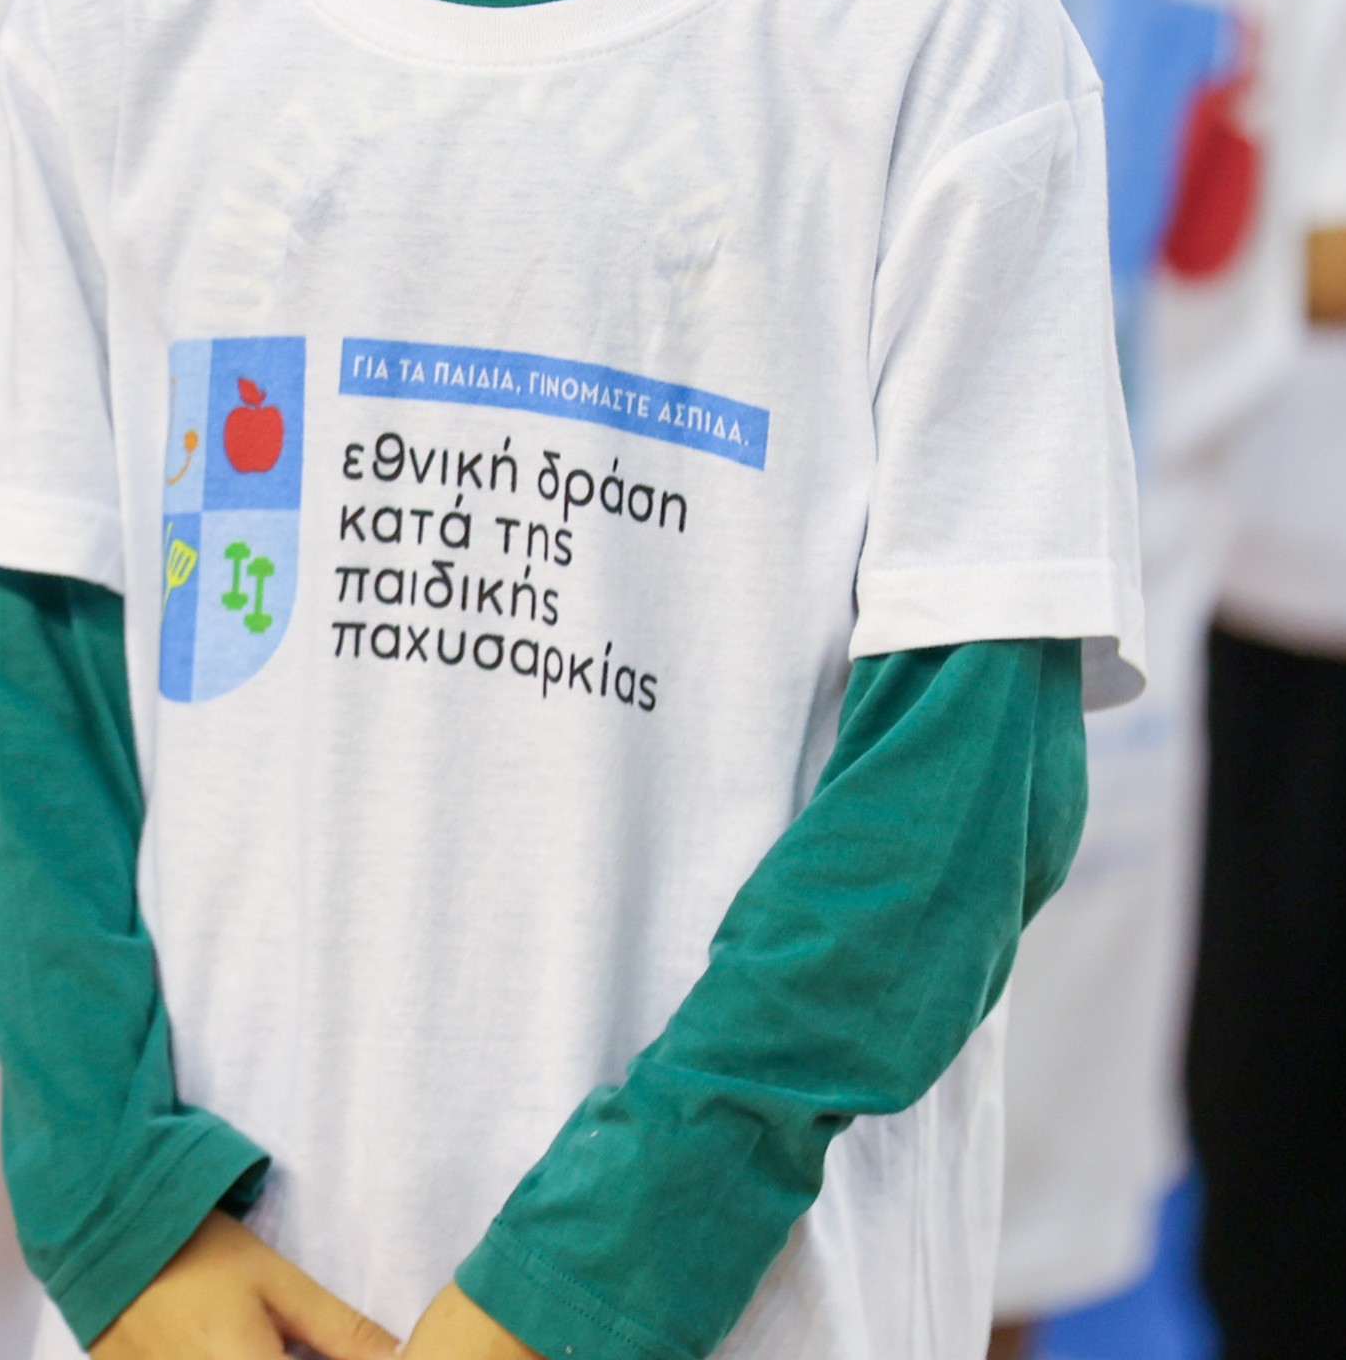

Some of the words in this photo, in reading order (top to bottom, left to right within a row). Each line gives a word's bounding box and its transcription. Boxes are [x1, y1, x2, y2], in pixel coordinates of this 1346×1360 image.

[352, 354, 390, 381] ΓΙΑ
[398, 358, 426, 383] ΤΑ
[433, 360, 522, 396] ΠΑΙΔΙΑ,
[529, 370, 652, 419] ΓΙΝΟΜΑΣΤΕ
[657, 399, 751, 447] ΑΣΠΙΔΑ.
[341, 431, 519, 494] εθνική
[536, 449, 688, 535] δράση
[339, 493, 473, 550] κατά
[495, 516, 574, 567] της
[334, 559, 559, 627] παιδικής
[331, 621, 659, 711] παχυσαρκίας
